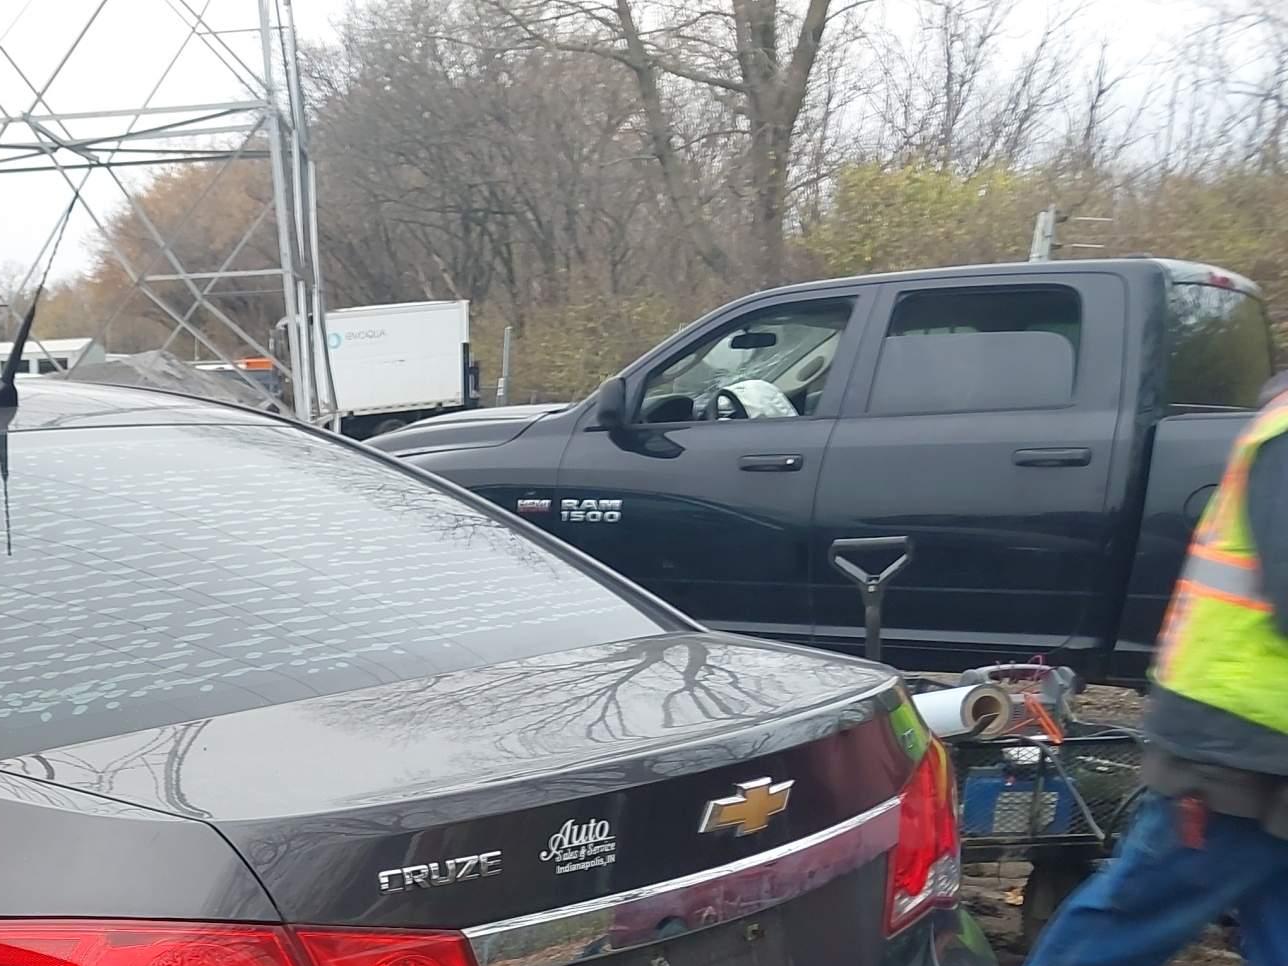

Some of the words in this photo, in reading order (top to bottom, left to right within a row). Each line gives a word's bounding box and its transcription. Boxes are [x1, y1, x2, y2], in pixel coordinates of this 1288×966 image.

[560, 499, 623, 510] RAM
[560, 511, 622, 522] 1500
[539, 818, 616, 861] Auto
[555, 849, 578, 862] Sales
[587, 842, 616, 856] Service
[378, 850, 503, 895] CRUZE
